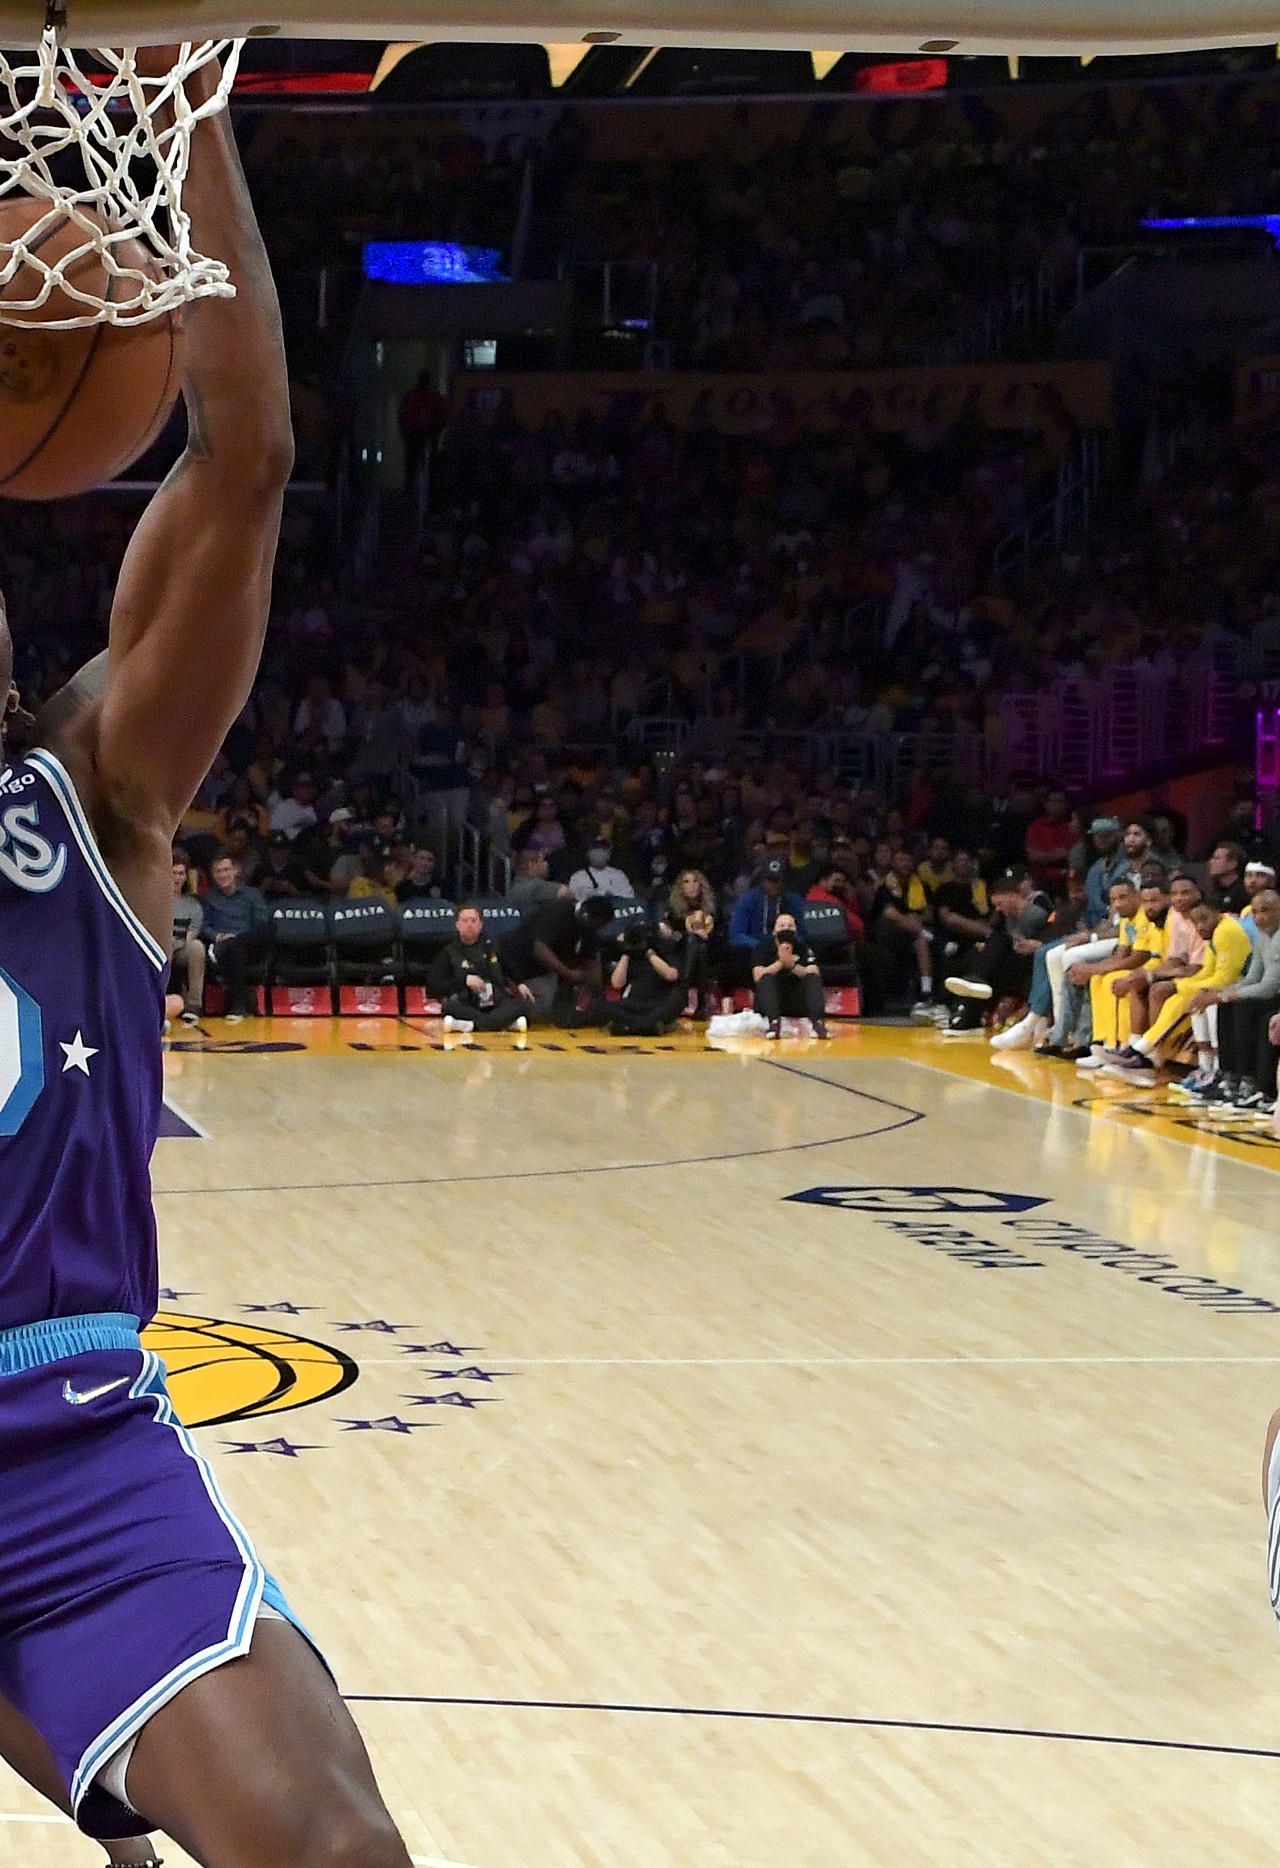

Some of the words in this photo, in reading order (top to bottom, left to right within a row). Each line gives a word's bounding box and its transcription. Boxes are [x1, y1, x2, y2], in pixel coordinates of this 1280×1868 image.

[285, 909, 324, 920] DELTA
[344, 905, 384, 919] DELTA
[413, 908, 454, 918] DELTA
